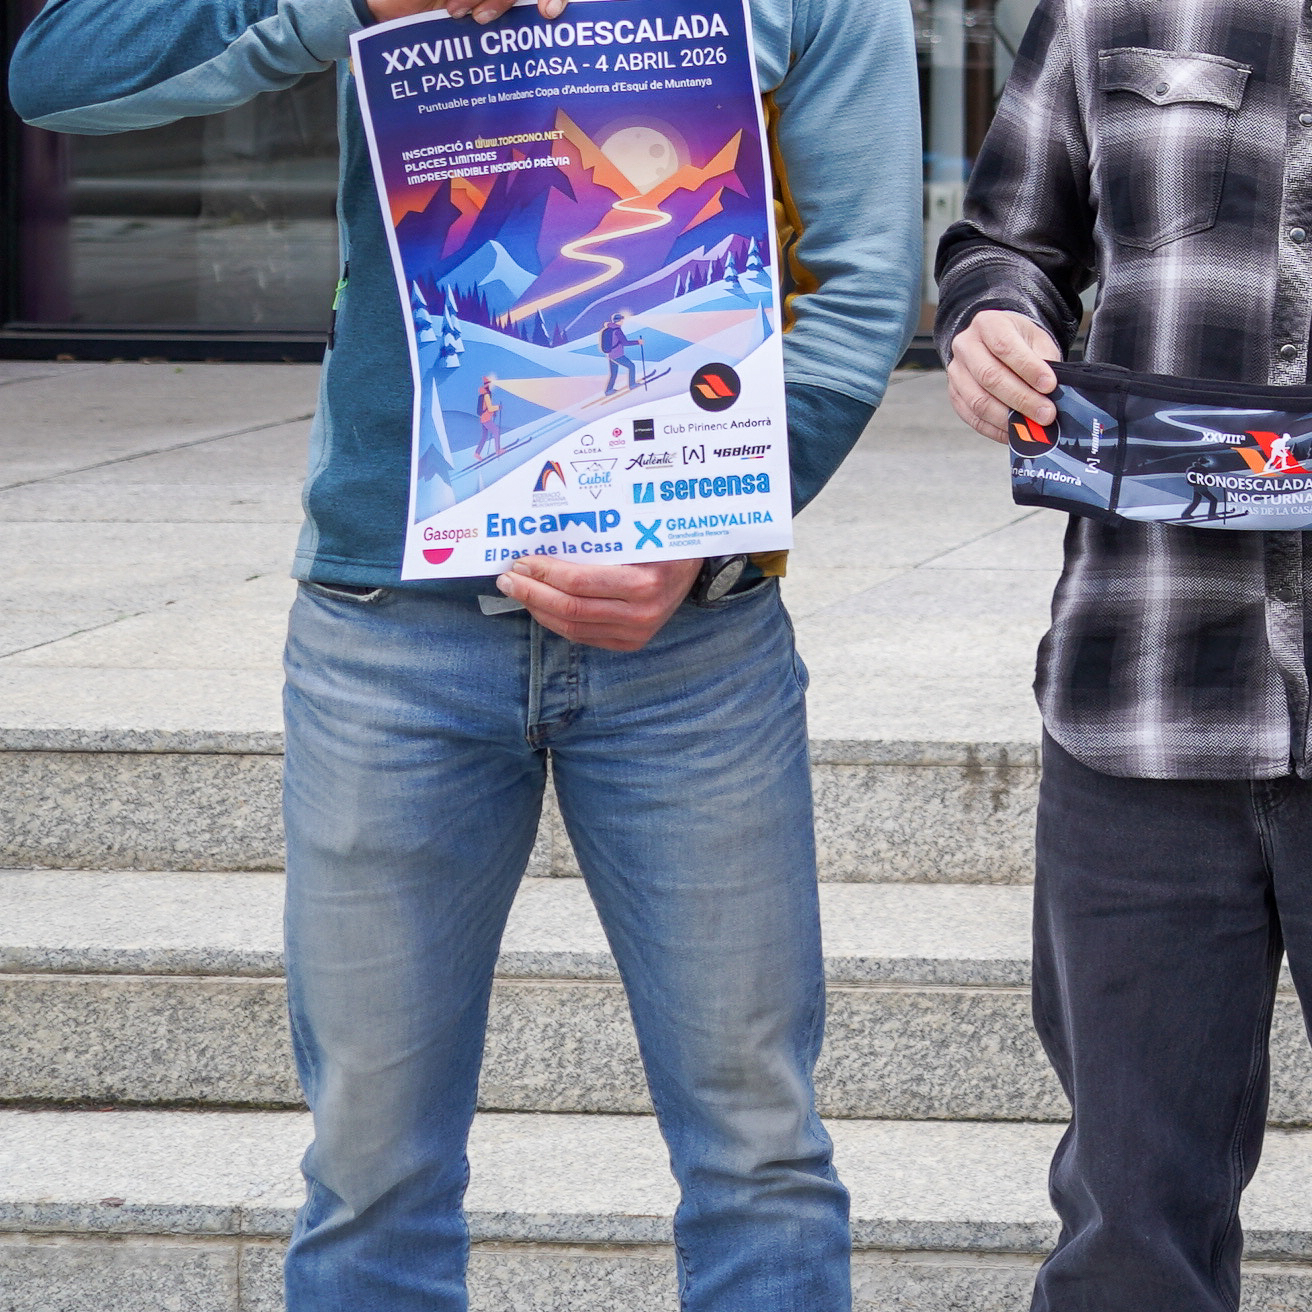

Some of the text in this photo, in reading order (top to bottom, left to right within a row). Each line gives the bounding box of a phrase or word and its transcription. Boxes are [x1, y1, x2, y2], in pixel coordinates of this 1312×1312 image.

[382, 13, 729, 75] XXVIII CRONOESCALADA
[391, 47, 727, 100] EL PAS DE LA CASA 4 ABRIL 2026
[418, 97, 469, 113] Puntuable
[471, 95, 486, 107] per
[488, 94, 497, 103] la
[498, 90, 534, 102] Morabanc
[535, 88, 559, 98] Copa
[562, 82, 610, 95] d'Andorra
[650, 79, 663, 89] de
[665, 76, 712, 89] Muntanya
[402, 140, 463, 161] INSCRIPCIÓ
[404, 151, 497, 173] PLACES LIMITADES
[407, 166, 489, 185] IMPRESCINDIBLE
[663, 424, 685, 435] Club
[688, 421, 728, 432] Pirinenc
[660, 472, 771, 501] sercensa
[1037, 468, 1082, 486] Andorrà
[666, 511, 773, 531] GRANDVALIRA
[1261, 506, 1275, 515] DE
[1276, 506, 1289, 515] LA
[486, 509, 621, 537] Encamp
[423, 526, 479, 543] Gasopas
[485, 541, 623, 562] El Pas de la Casa
